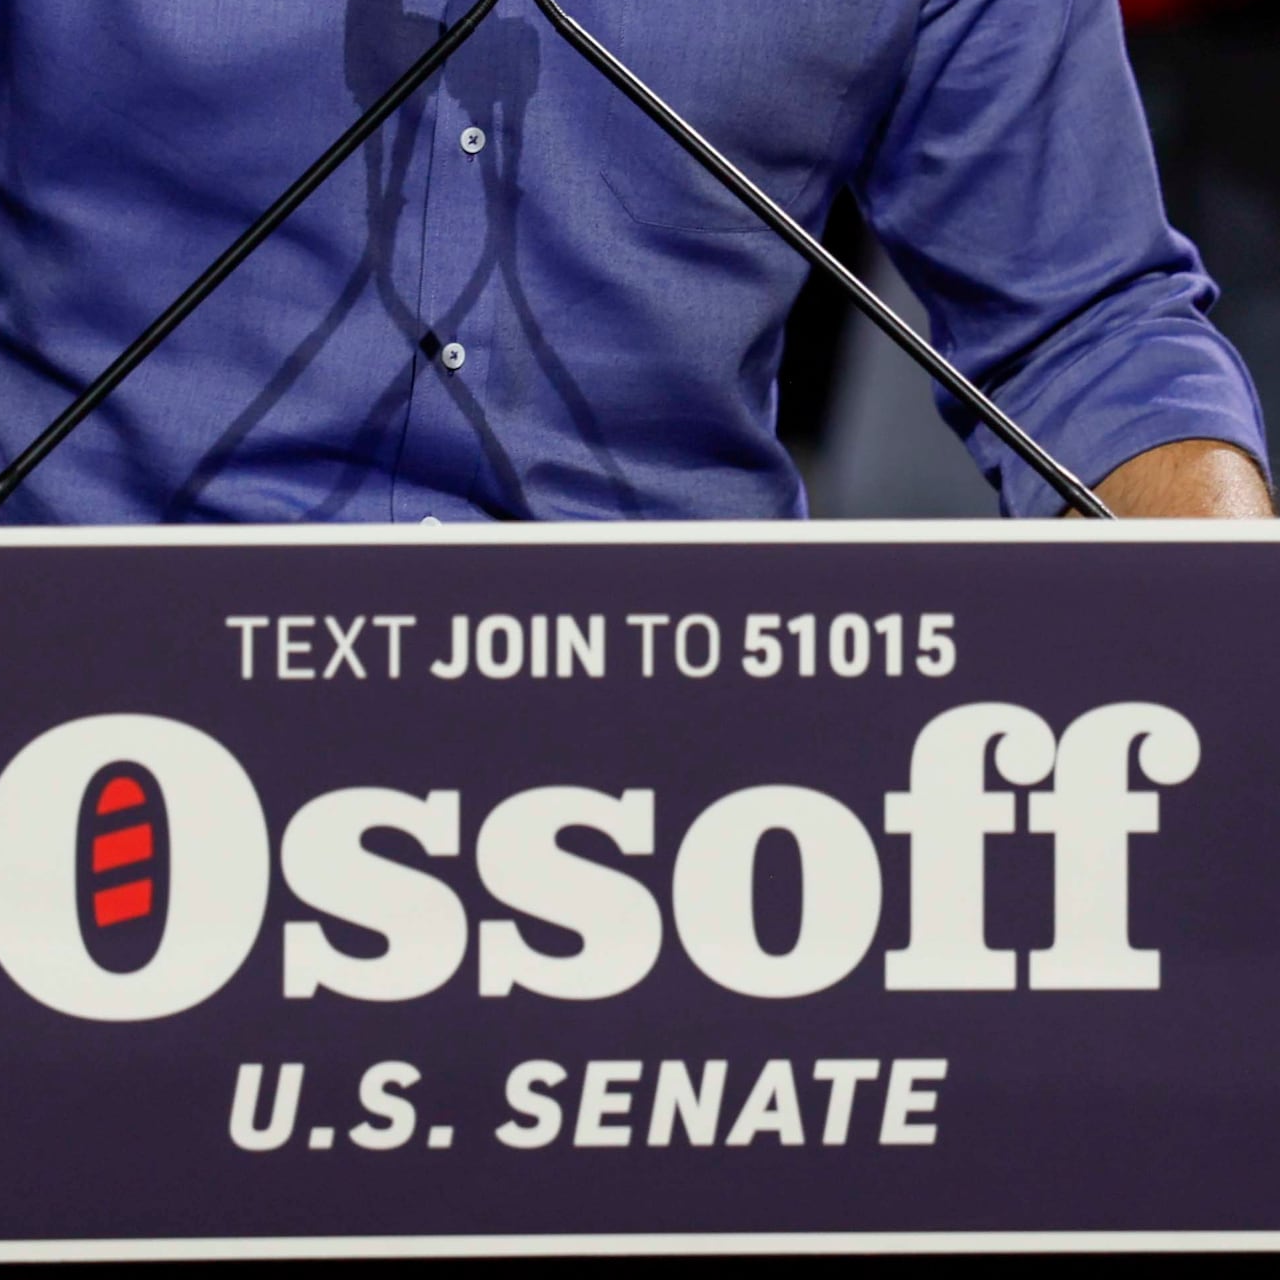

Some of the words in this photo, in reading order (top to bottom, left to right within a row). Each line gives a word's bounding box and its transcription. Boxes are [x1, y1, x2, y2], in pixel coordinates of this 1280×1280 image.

[226, 614, 416, 680] TEXT
[430, 613, 606, 680] JOIN
[626, 613, 721, 679] TO
[742, 612, 957, 679] 51015
[228, 1061, 454, 1151] U.S.
[495, 1058, 949, 1149] SENATE
